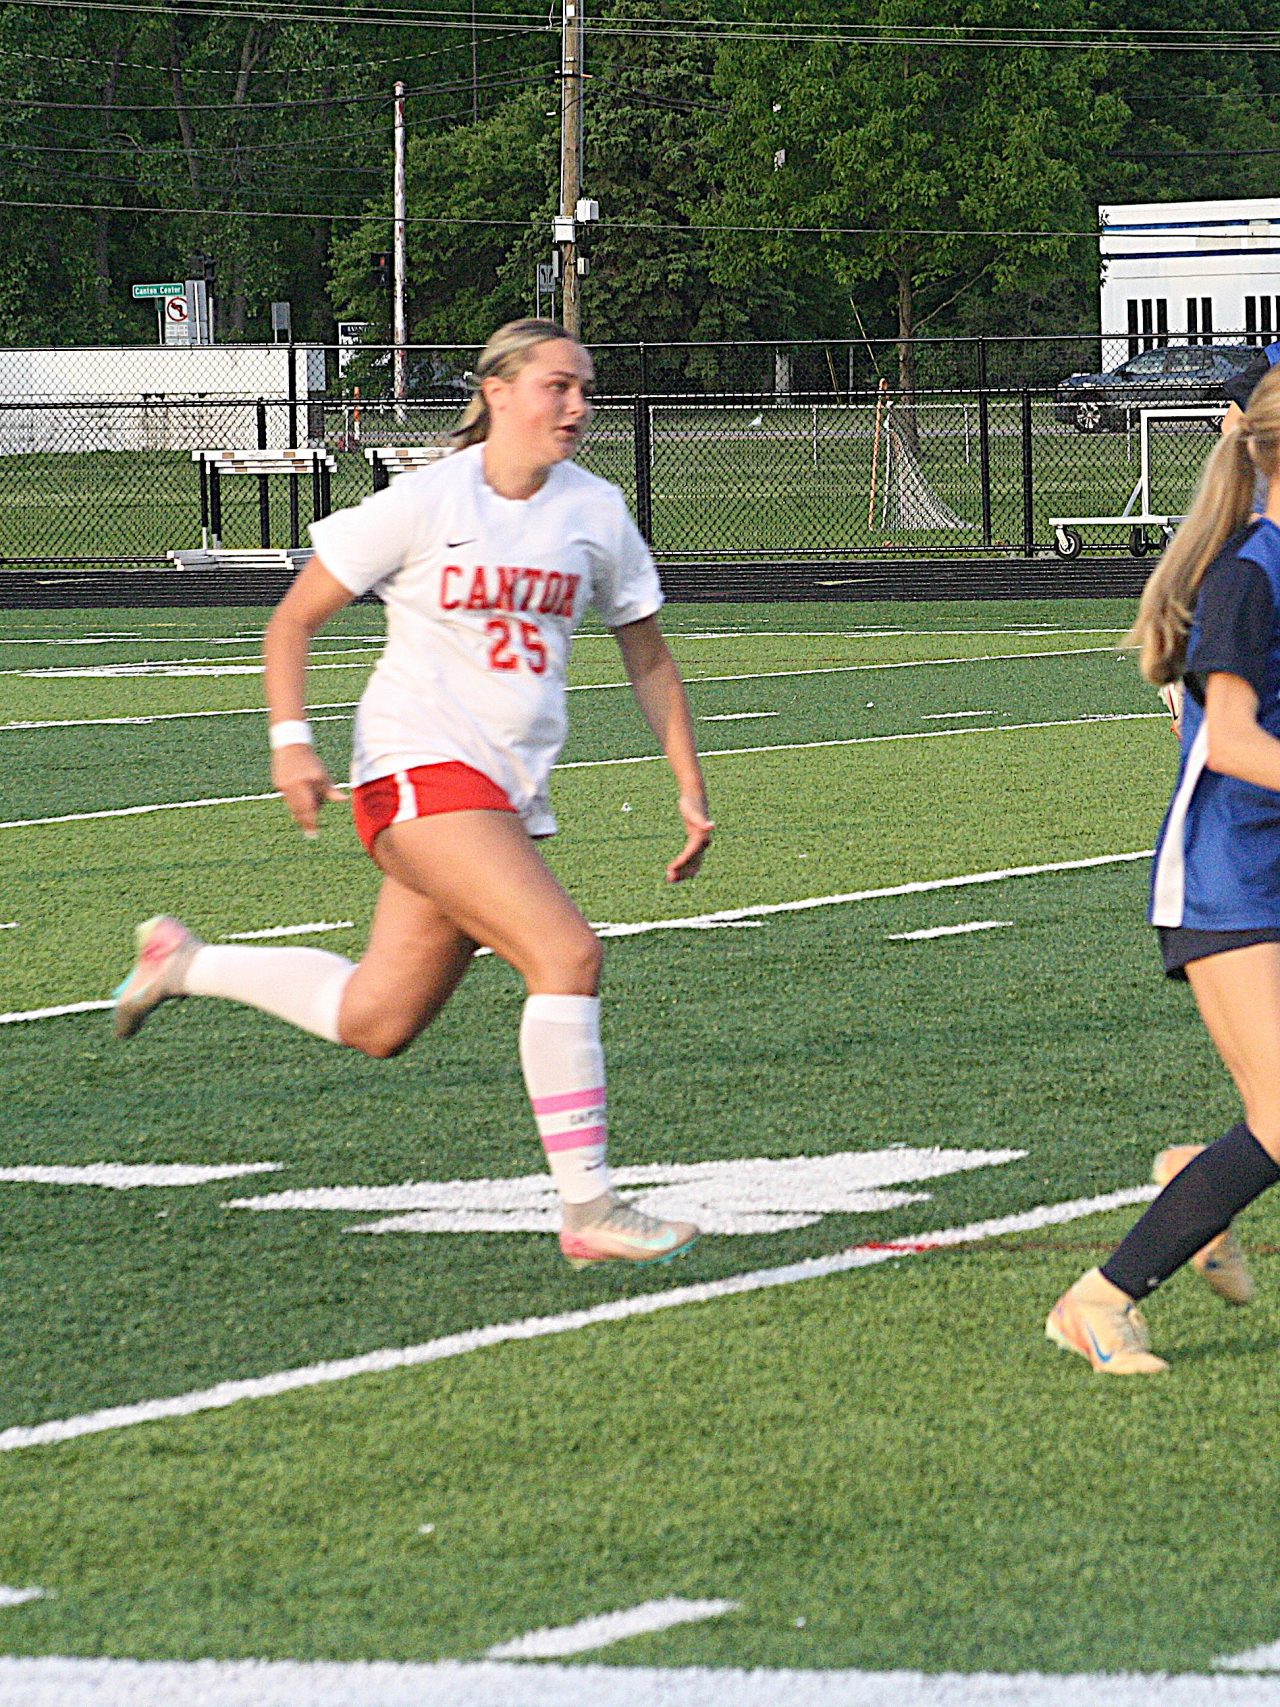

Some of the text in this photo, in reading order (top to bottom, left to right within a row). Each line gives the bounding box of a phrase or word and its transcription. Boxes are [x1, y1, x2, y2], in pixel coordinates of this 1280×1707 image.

[134, 286, 181, 295] Canton Center
[440, 564, 581, 618] CANTON
[486, 616, 547, 675] 25
